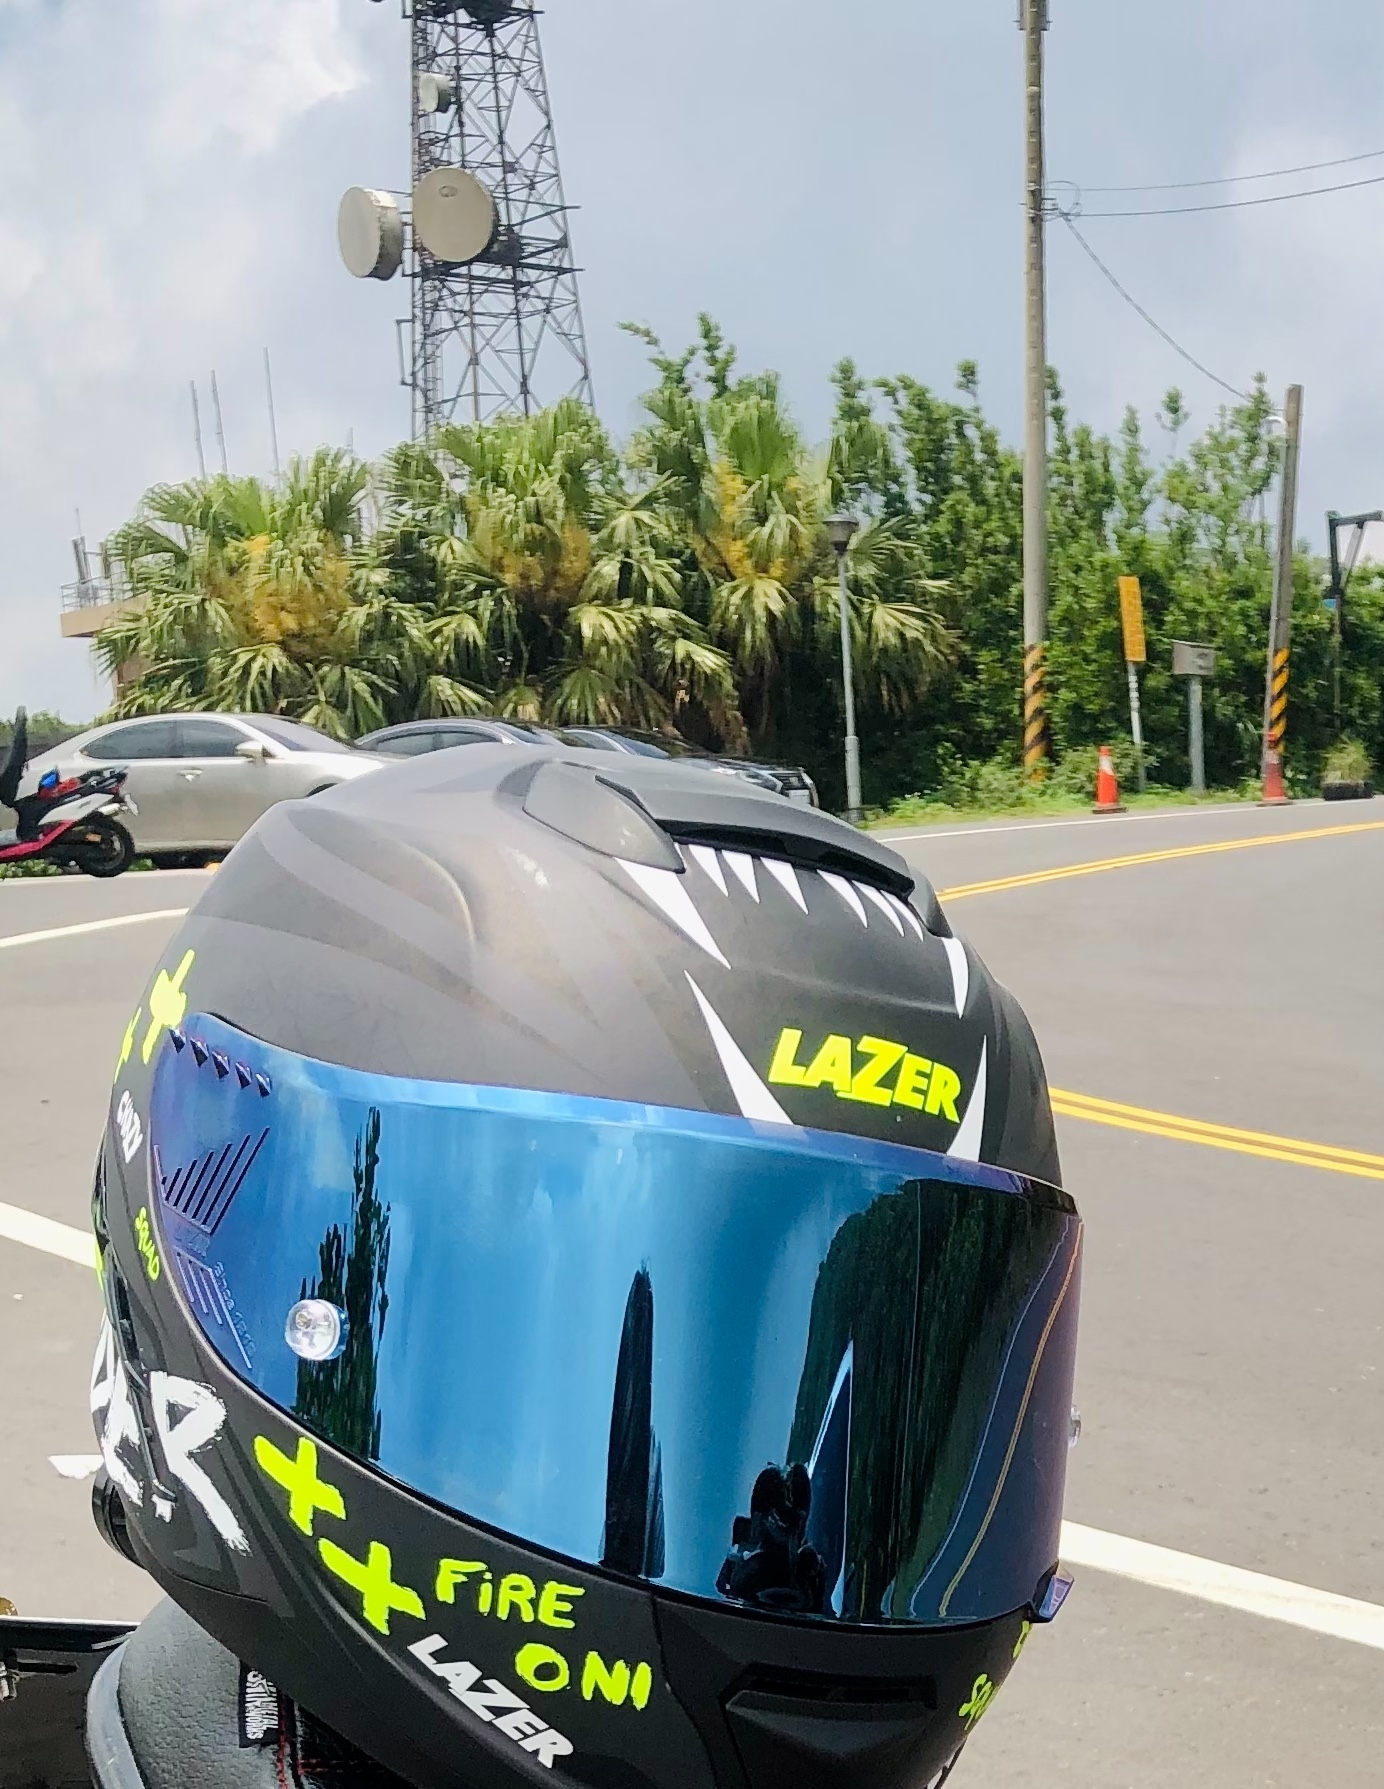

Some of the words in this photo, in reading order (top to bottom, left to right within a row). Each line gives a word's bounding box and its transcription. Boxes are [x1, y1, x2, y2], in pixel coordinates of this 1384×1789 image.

[768, 1027, 962, 1123] LAZER
[407, 1633, 574, 1769] LAZER
[515, 1642, 652, 1711] ONI
